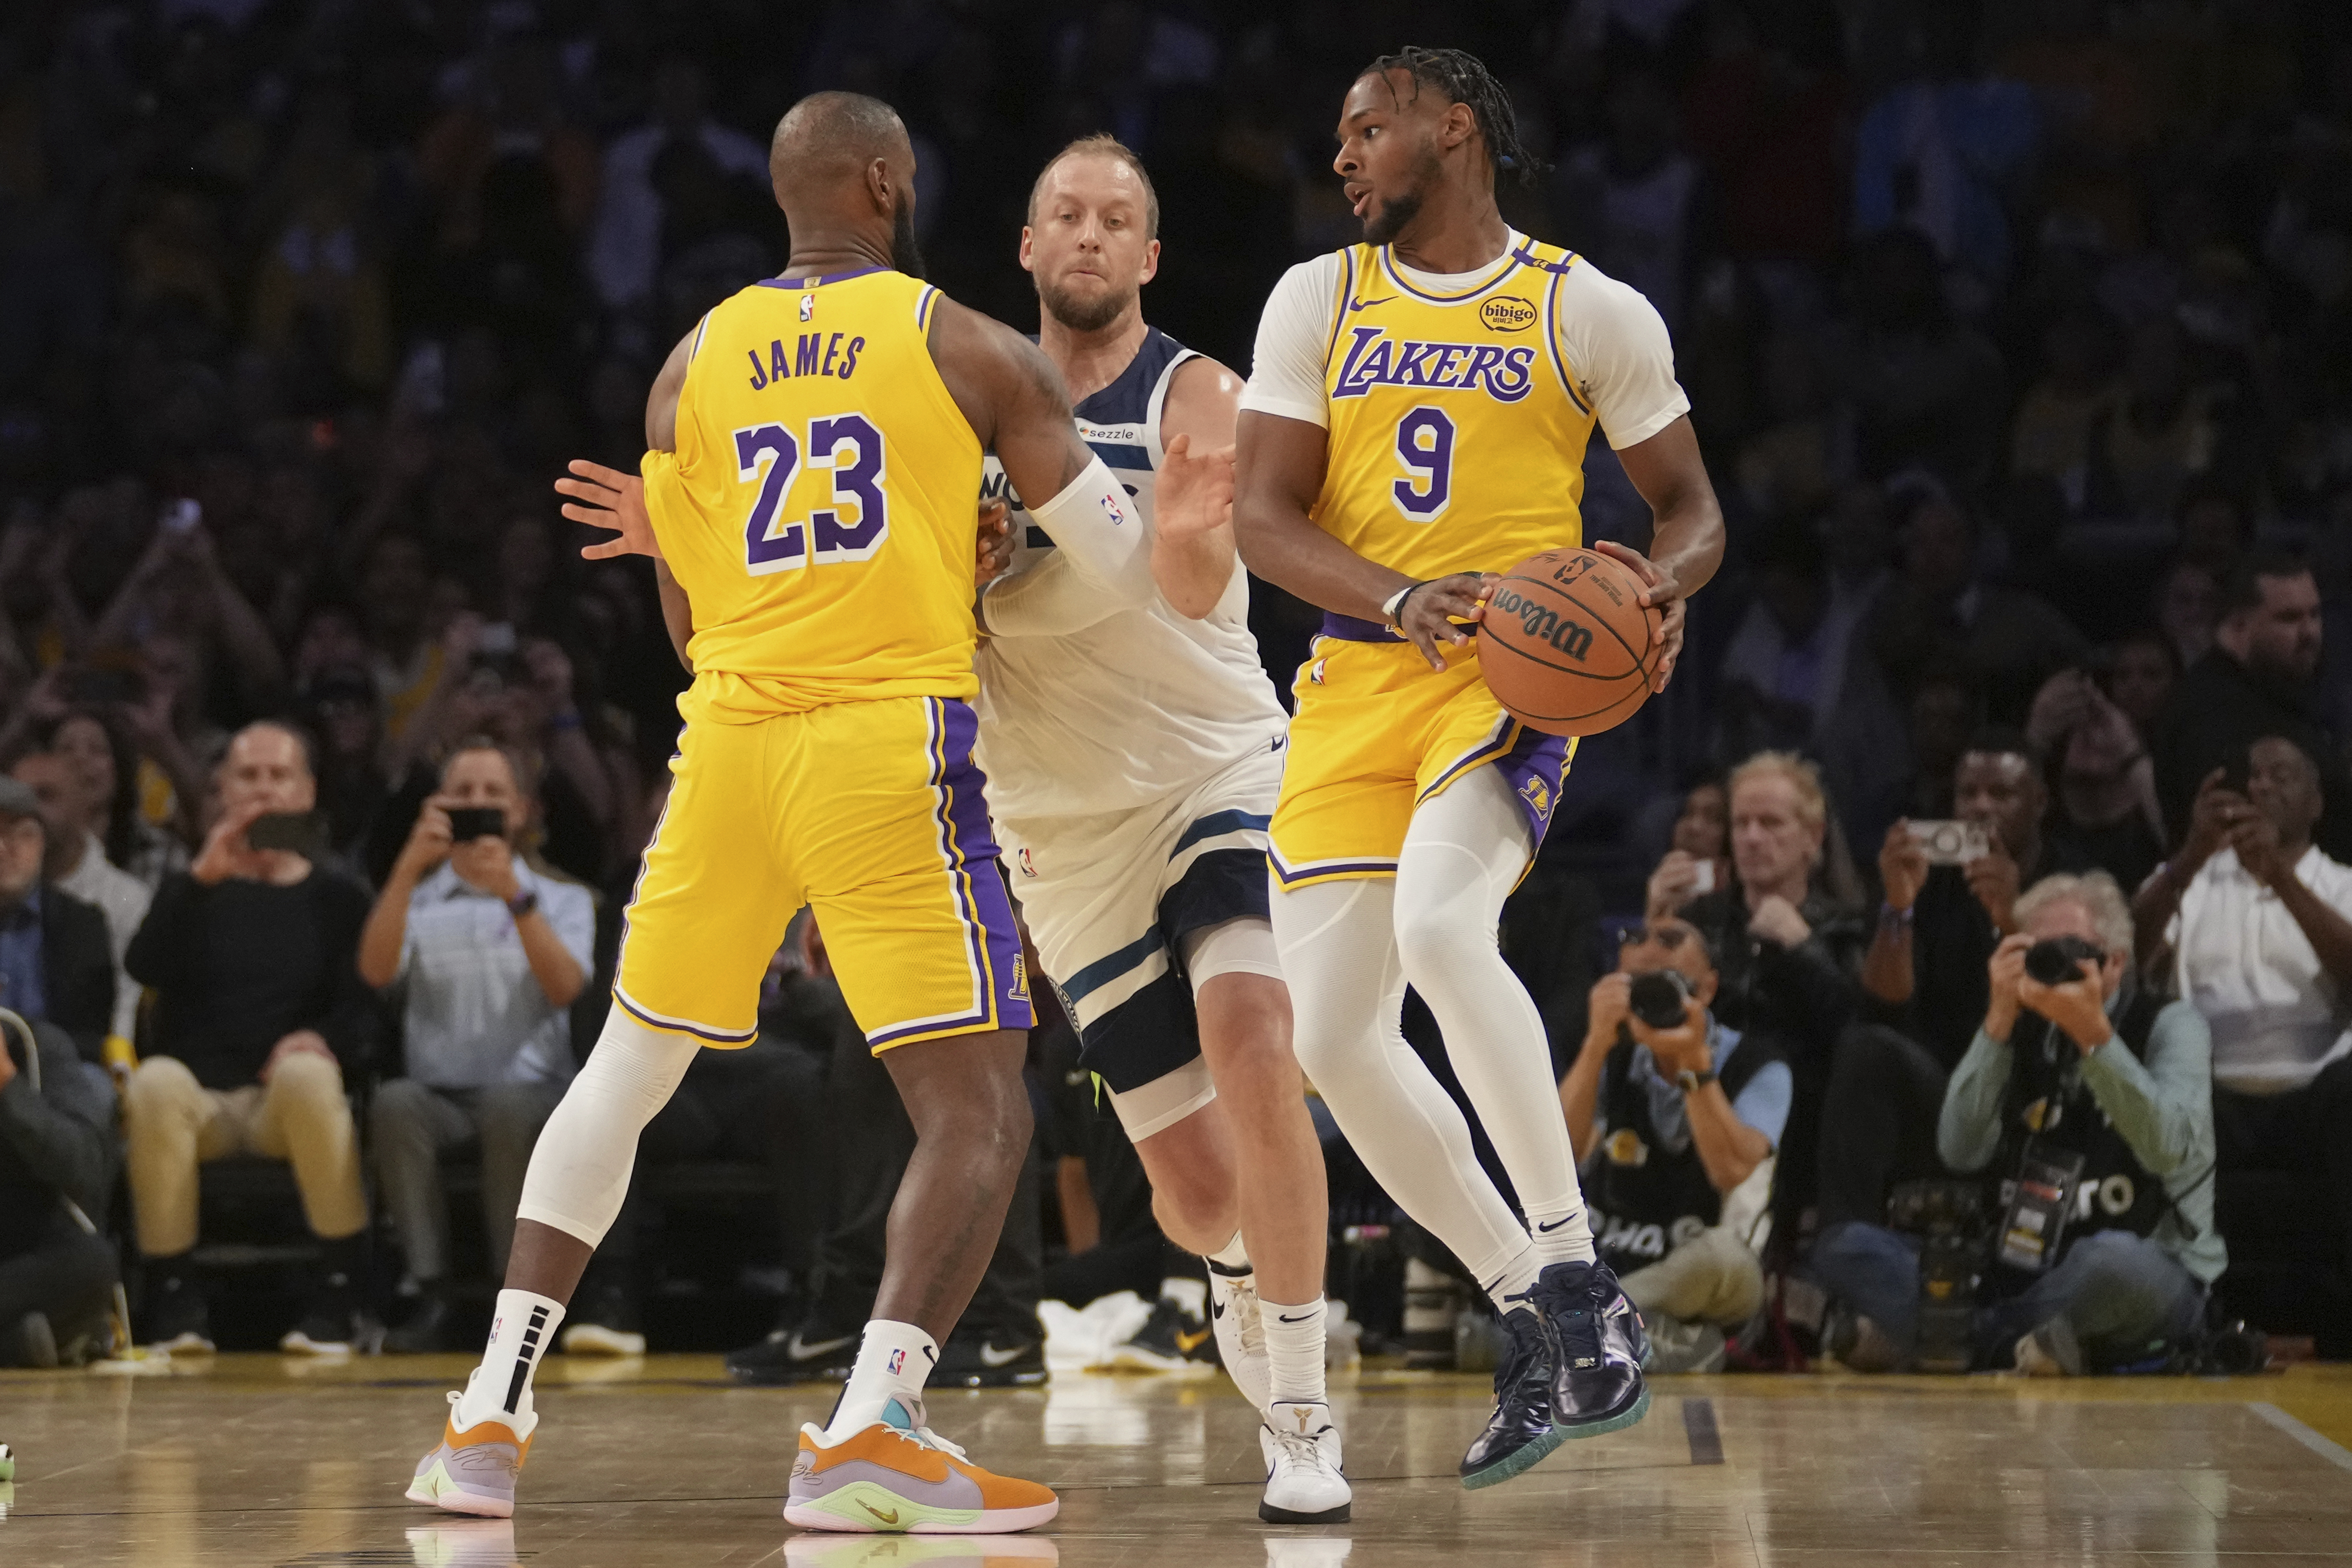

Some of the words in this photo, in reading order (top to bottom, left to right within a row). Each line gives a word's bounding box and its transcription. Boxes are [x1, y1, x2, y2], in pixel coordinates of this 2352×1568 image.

[1532, 259, 1549, 269] 44
[1485, 304, 1534, 322] bibigo
[748, 332, 866, 391] JAMES
[1332, 326, 1535, 404] LAKERS
[1089, 429, 1134, 439] sezzle
[1391, 405, 1457, 523] 9
[732, 411, 889, 577] 23
[1493, 587, 1593, 664] Wilson
